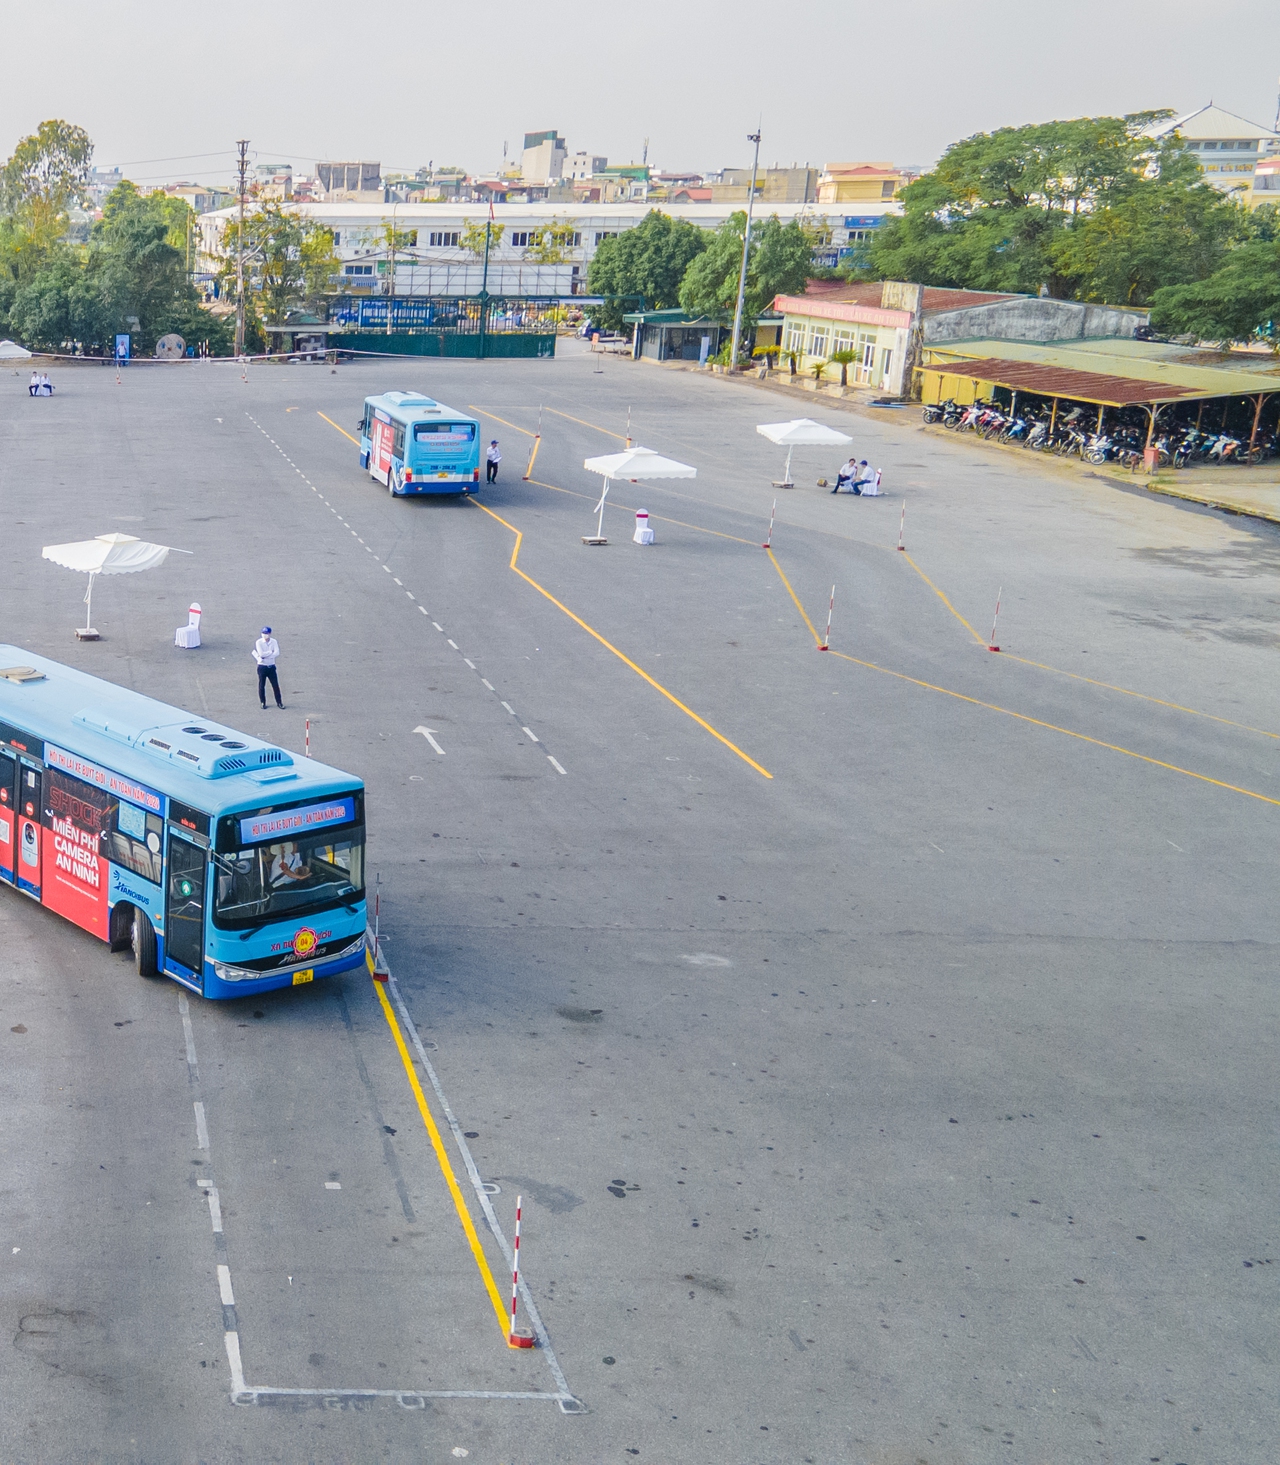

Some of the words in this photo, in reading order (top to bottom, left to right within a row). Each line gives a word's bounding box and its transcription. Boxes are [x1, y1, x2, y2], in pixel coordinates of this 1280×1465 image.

[75, 762, 81, 773] XE
[110, 777, 117, 790] AN
[306, 813, 312, 824] AN
[52, 815, 79, 844] MIỄN
[80, 831, 99, 853] PHÍ
[54, 837, 99, 870] CAMERA
[56, 853, 71, 872] AN
[72, 860, 99, 888] NINH
[301, 938, 308, 946] 04
